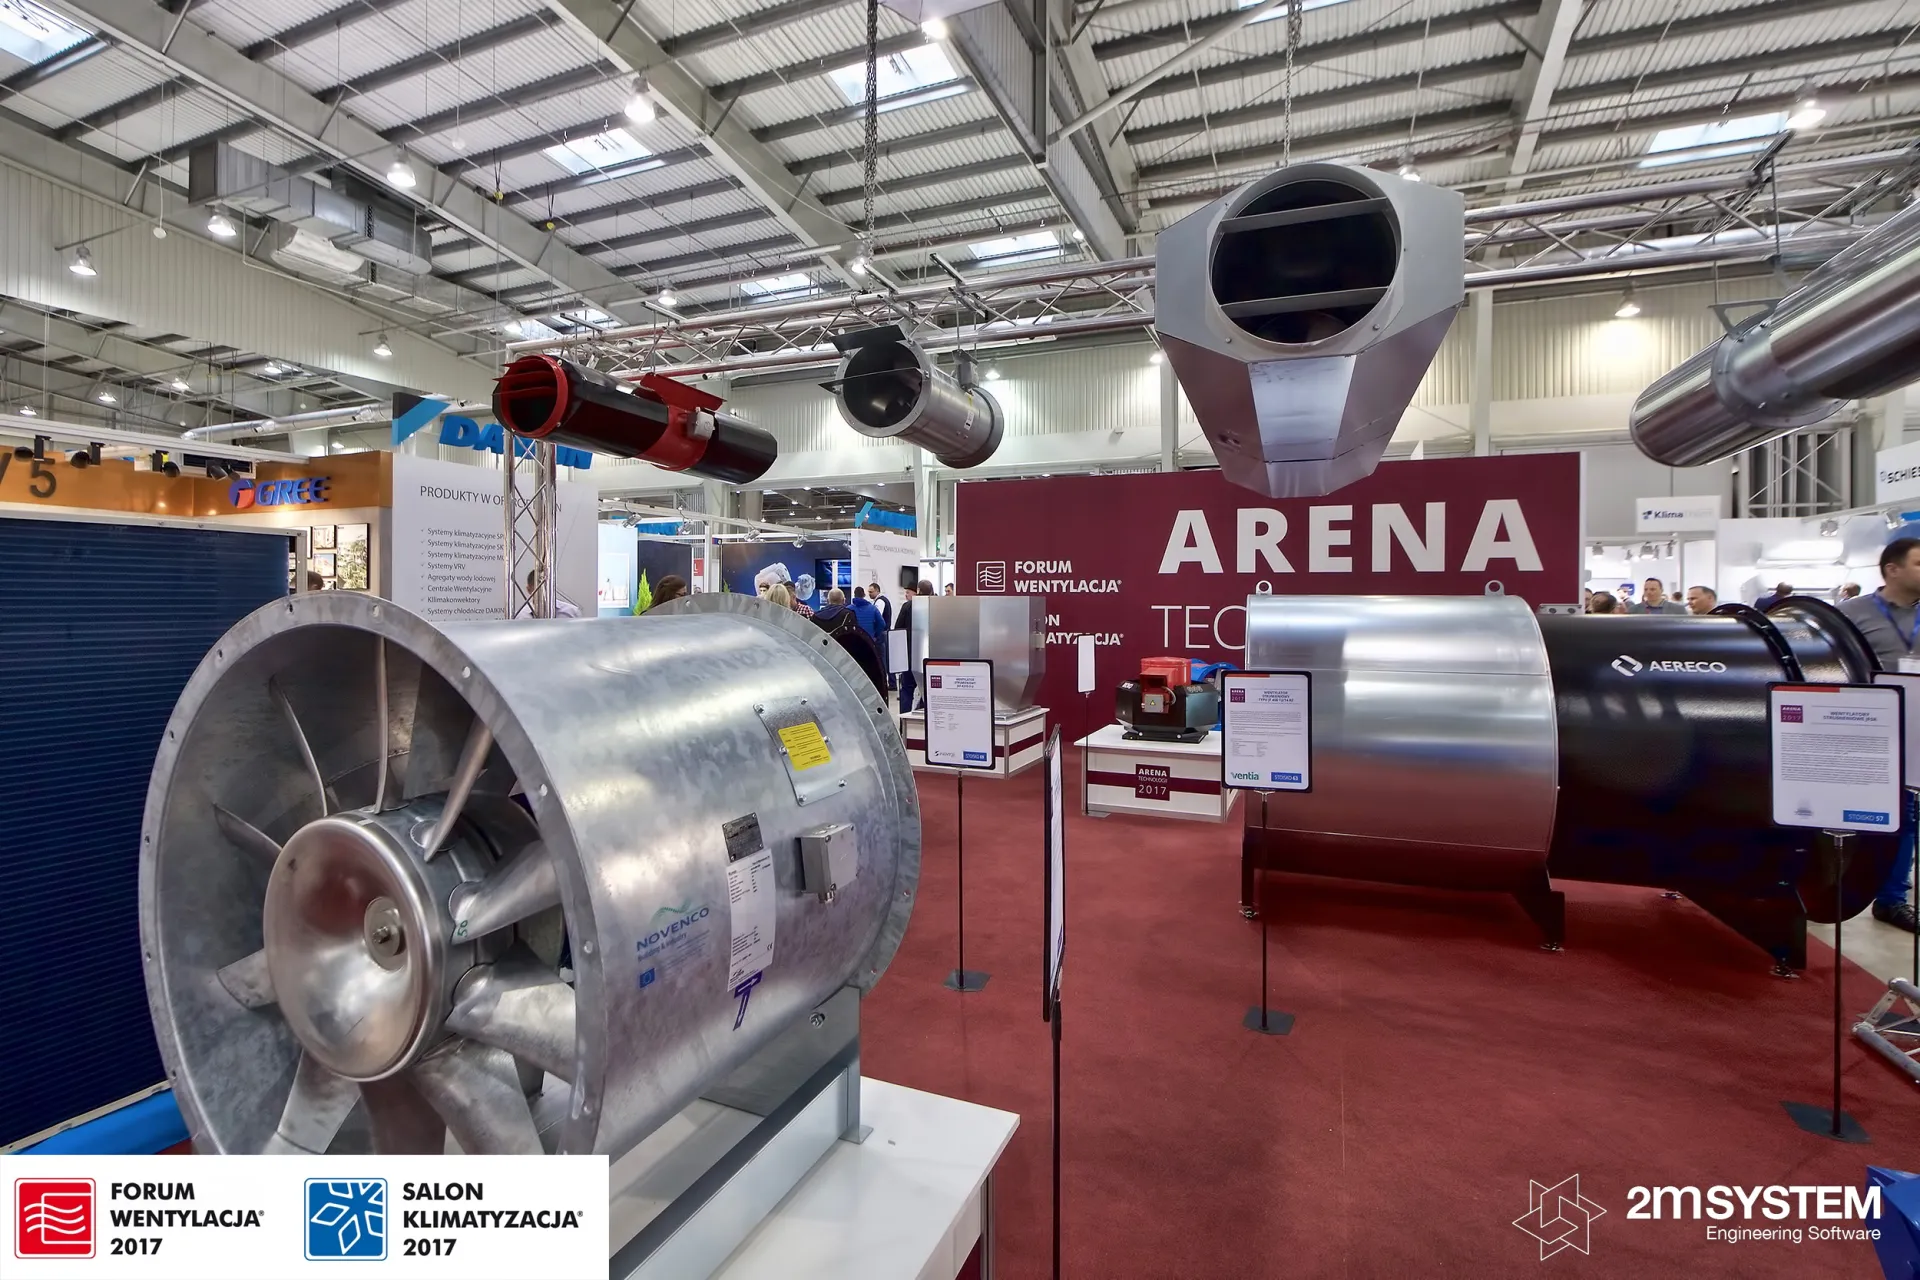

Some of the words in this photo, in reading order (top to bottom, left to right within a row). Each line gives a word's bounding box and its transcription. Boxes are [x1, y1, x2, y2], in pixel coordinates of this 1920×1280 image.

[256, 477, 331, 506] GREE
[420, 486, 479, 504] PRODUKTY
[480, 493, 491, 504] W
[427, 528, 453, 538] Systemy
[454, 530, 496, 540] klimatyzacyjne
[1158, 499, 1544, 574] ARENA
[427, 539, 453, 549] Systemy
[454, 541, 496, 551] klimatyzacyjne
[427, 550, 453, 560] Systemy
[454, 552, 496, 562] klimatyzacyjne
[427, 562, 453, 571] Systemy
[1014, 560, 1073, 574] FORUM
[427, 574, 456, 582] Agregaty
[454, 585, 492, 594] Wentylacyjne
[1649, 660, 1727, 673] AERECO
[1138, 768, 1167, 777] ARENA
[1231, 771, 1259, 780] ventia
[1138, 784, 1167, 795] 2017
[636, 907, 710, 952] NOVENCO
